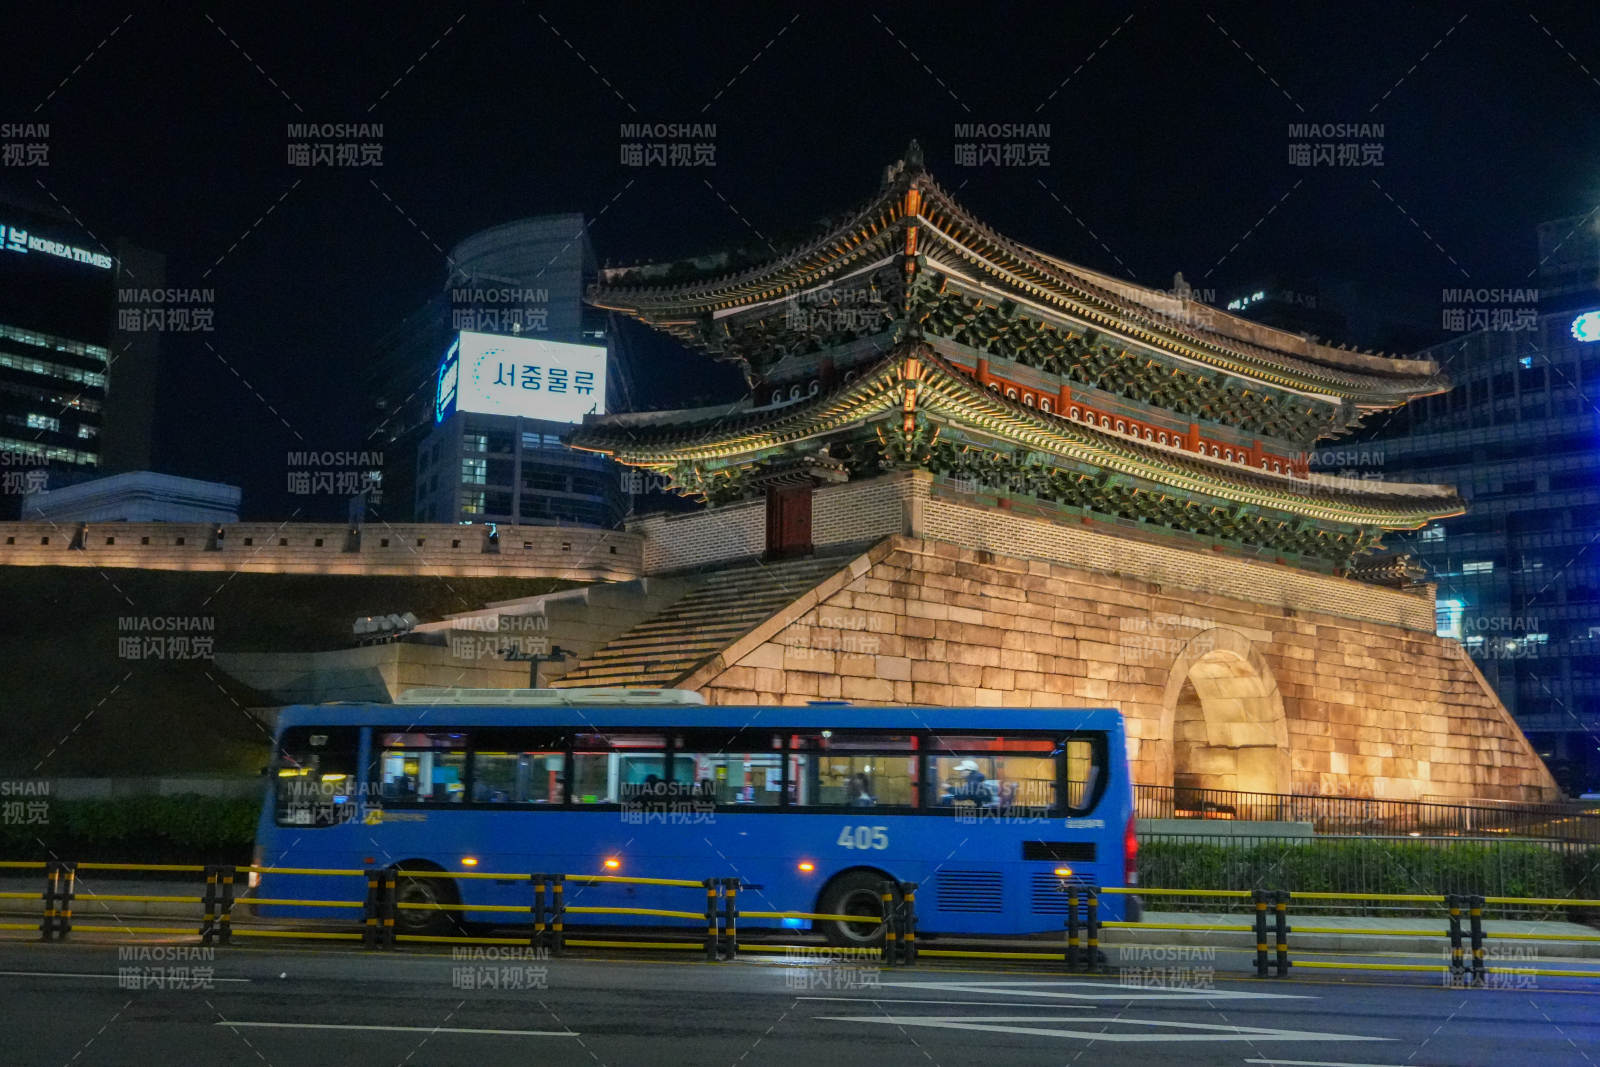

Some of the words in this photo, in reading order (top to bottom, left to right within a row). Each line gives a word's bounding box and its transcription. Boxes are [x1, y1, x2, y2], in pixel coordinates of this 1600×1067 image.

[0, 224, 28, 253] 보
[29, 235, 72, 259] KOREA
[72, 247, 112, 269] TIMES
[492, 362, 596, 396] 서중물류
[837, 825, 889, 850] 405
